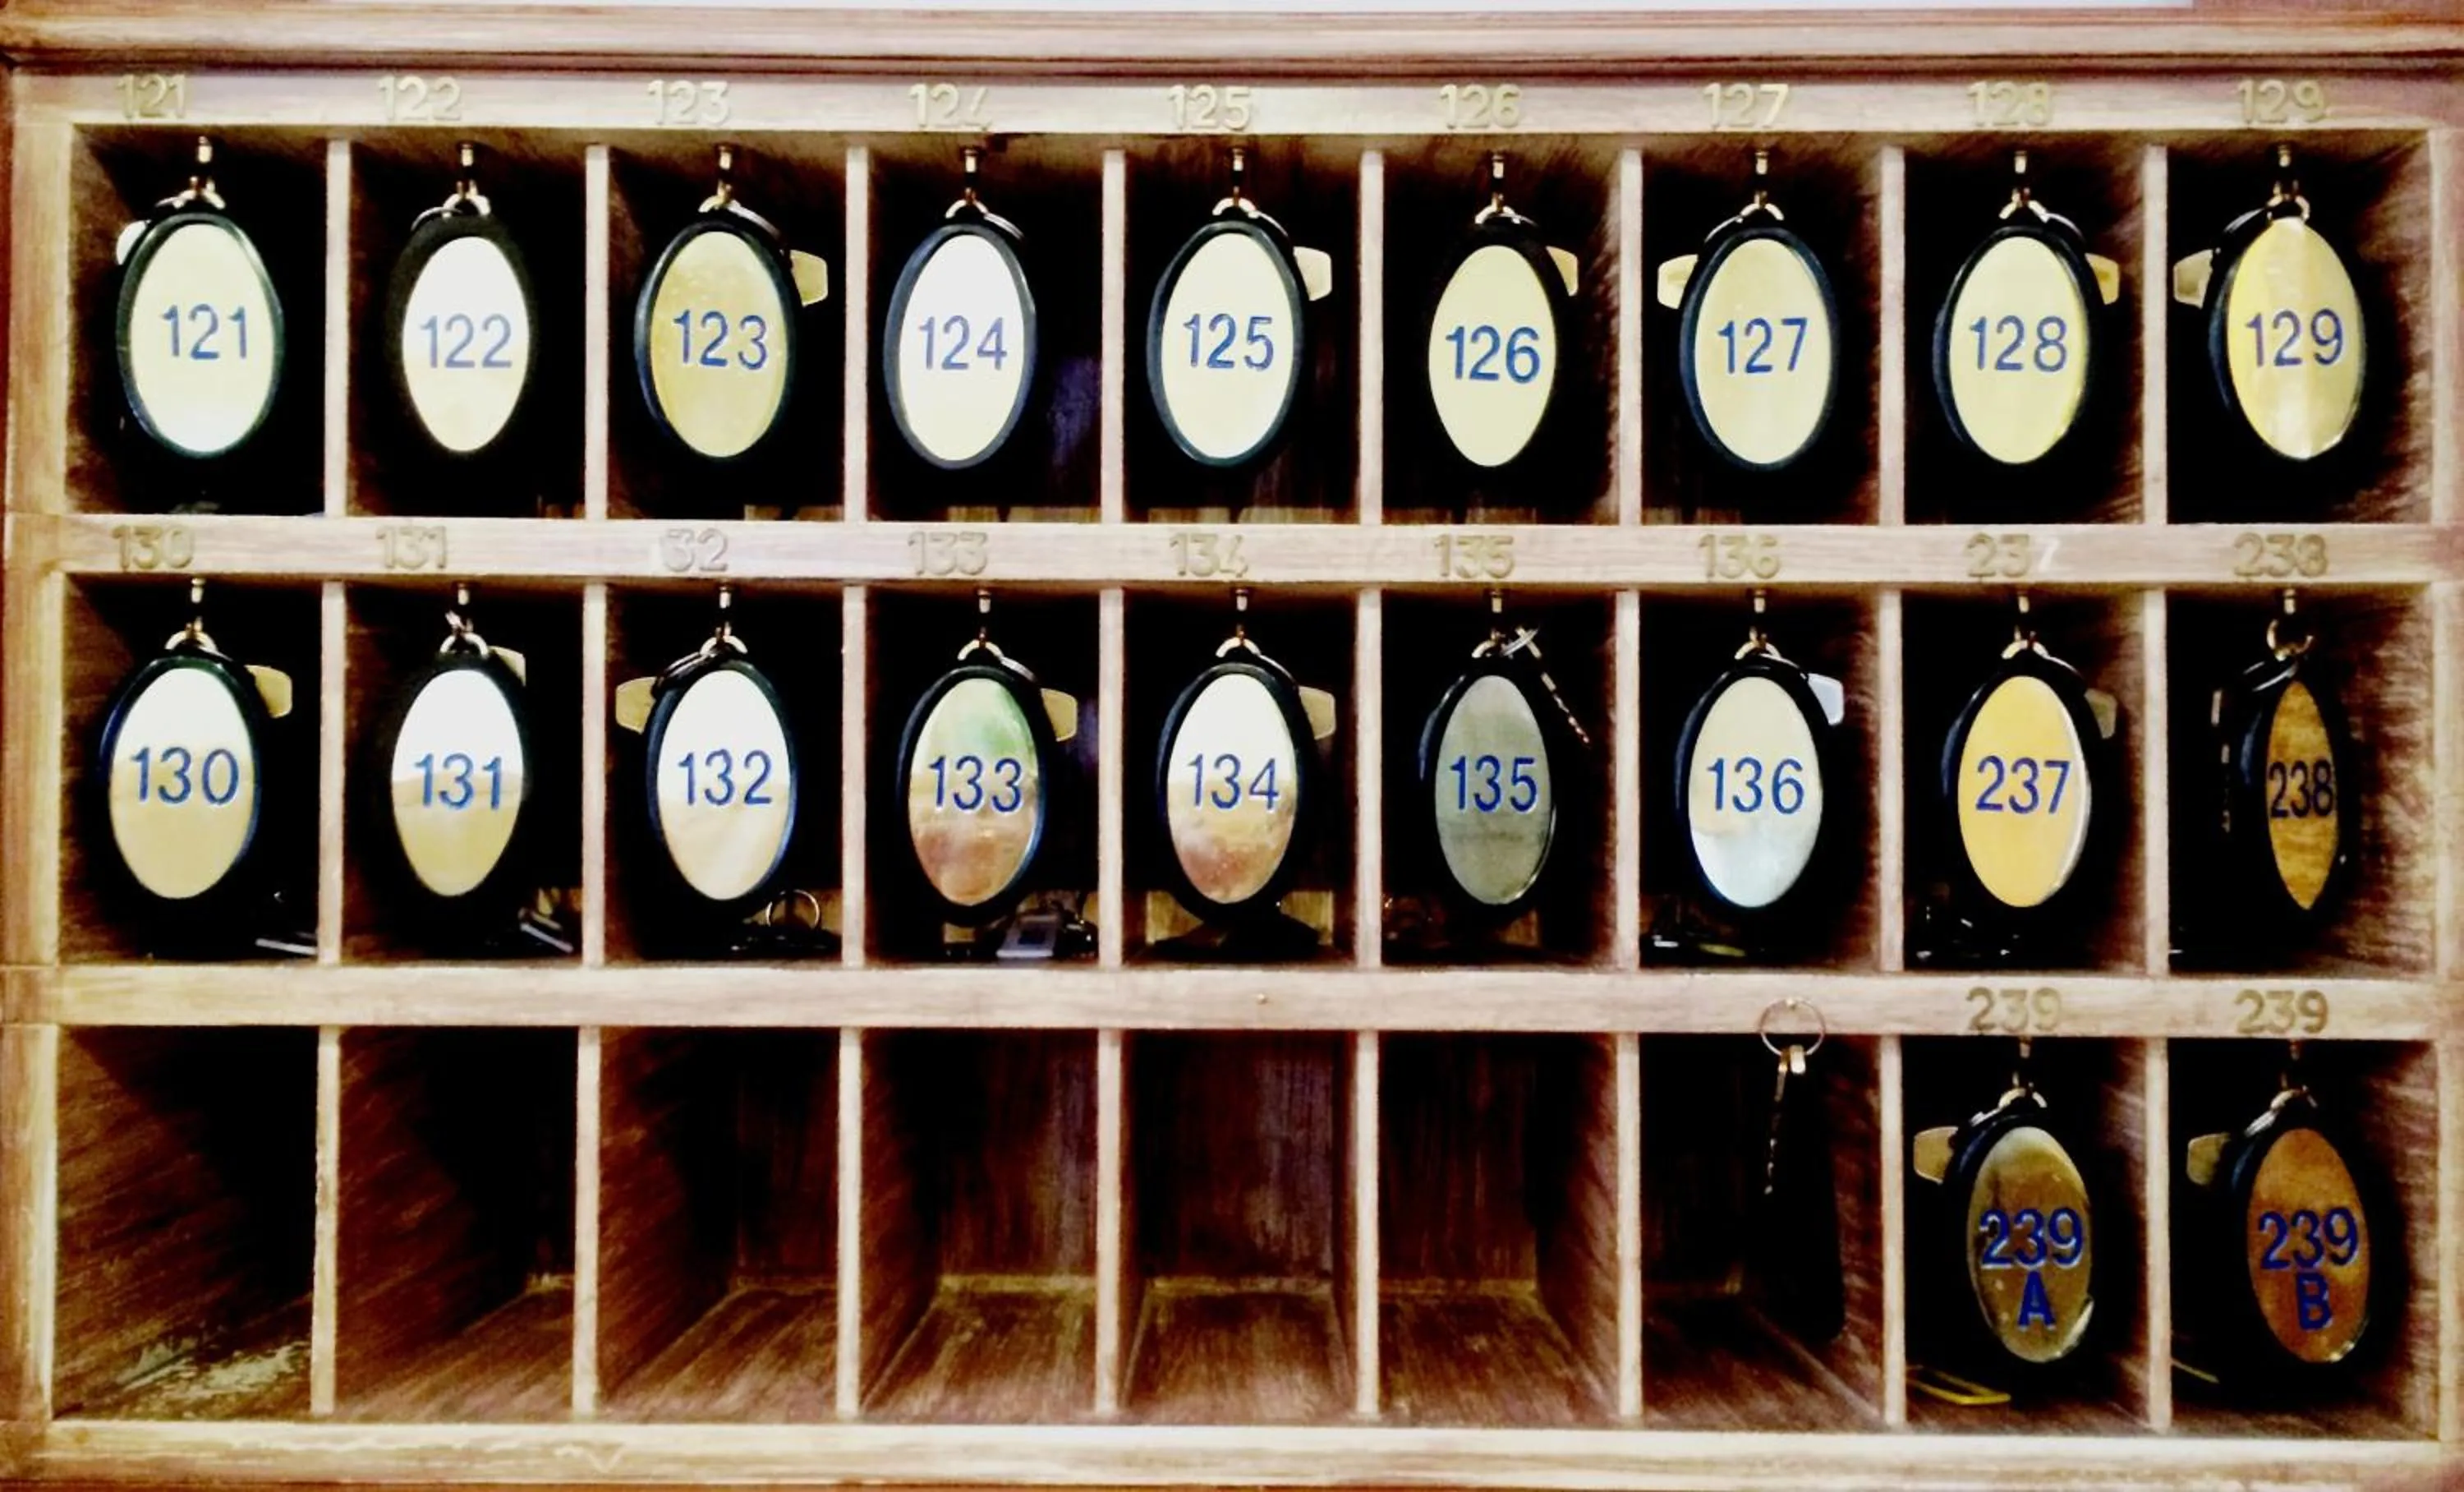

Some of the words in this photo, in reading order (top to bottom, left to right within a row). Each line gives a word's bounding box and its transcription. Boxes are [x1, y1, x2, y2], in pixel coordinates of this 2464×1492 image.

[117, 75, 186, 119] 121
[379, 76, 462, 122] 122
[647, 80, 731, 127] 123
[1168, 84, 1250, 131] 125
[1440, 85, 1523, 130] 126
[1702, 84, 1789, 130] 127
[1967, 81, 2052, 127] 128
[2238, 81, 2328, 125] 129
[162, 304, 248, 361] 121
[420, 313, 513, 369] 122
[673, 309, 768, 371] 123
[917, 315, 1008, 371] 124
[1182, 313, 1275, 370] 125
[1445, 325, 1540, 382] 126
[1717, 316, 1809, 375] 127
[1969, 315, 2068, 373] 128
[2245, 309, 2343, 368] 129
[112, 526, 195, 570] 130
[376, 526, 447, 570] 131
[908, 531, 987, 576] 133
[1170, 532, 1248, 578] 134
[1433, 534, 1515, 578] 135
[1698, 534, 1781, 579] 136
[1963, 533, 2061, 578] 237
[2233, 532, 2328, 578] 238
[130, 747, 239, 806] 130
[414, 754, 502, 810] 131
[678, 748, 772, 806] 132
[928, 756, 1023, 812] 133
[1187, 753, 1280, 810] 134
[1449, 756, 1538, 812] 135
[1707, 756, 1804, 814] 136
[1975, 756, 2071, 814] 237
[2269, 760, 2334, 819] 238
[1965, 988, 2062, 1032] 239
[2234, 989, 2329, 1034] 239
[1979, 1208, 2085, 1269] 239
[2257, 1208, 2359, 1272] 239
[2016, 1272, 2056, 1330] A
[2299, 1272, 2333, 1330] B
